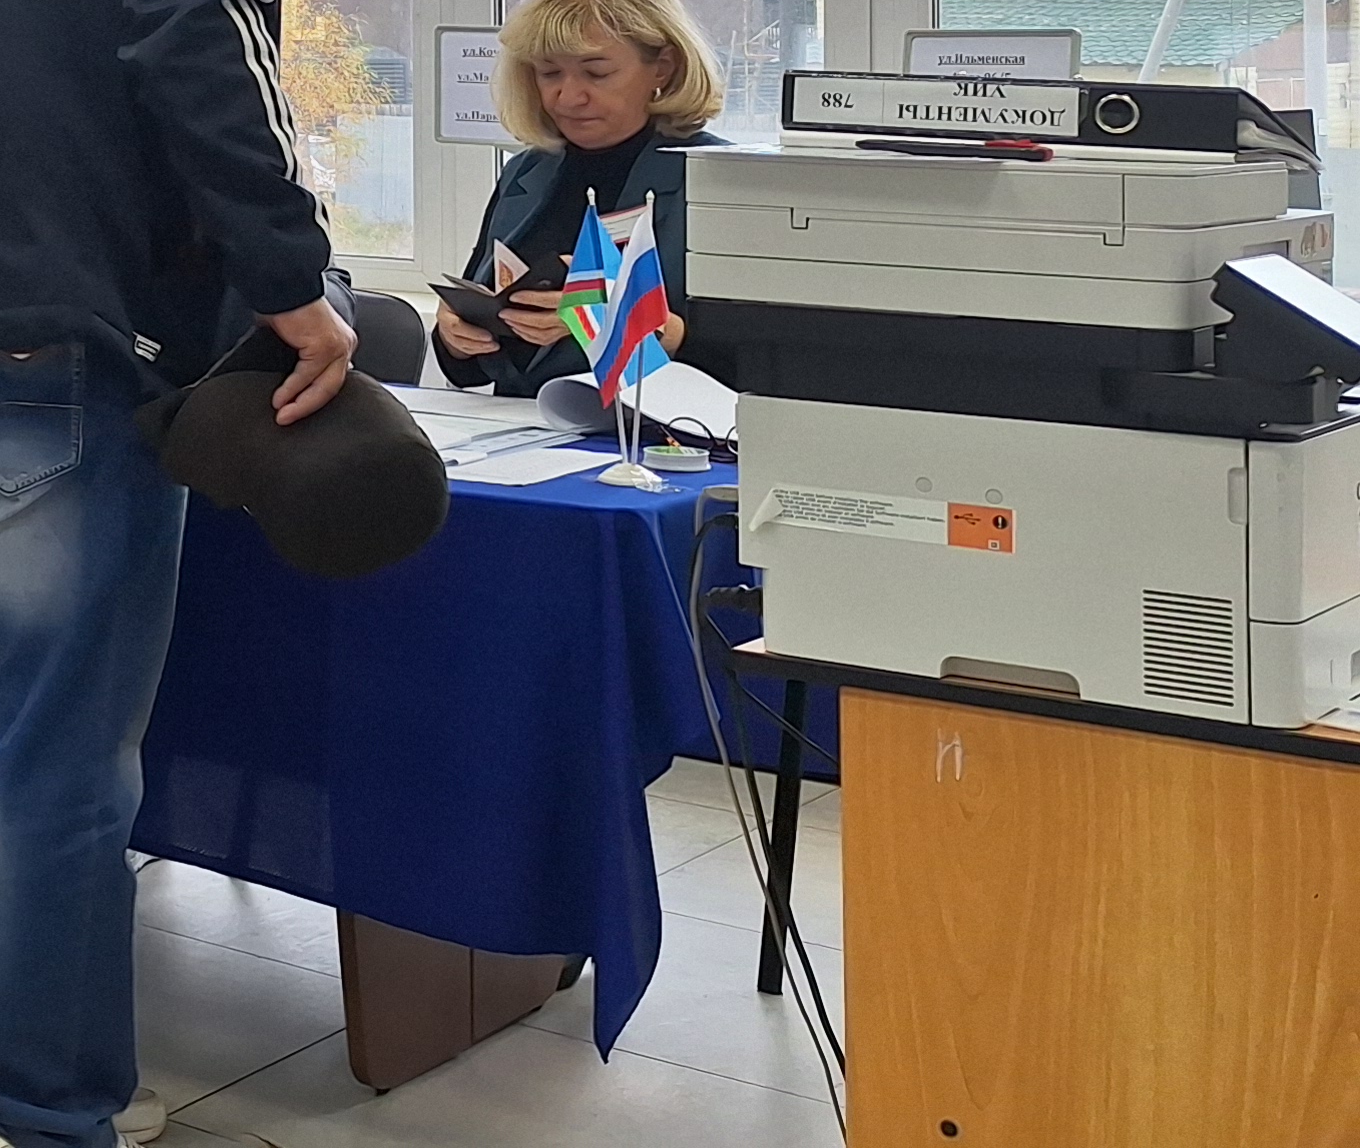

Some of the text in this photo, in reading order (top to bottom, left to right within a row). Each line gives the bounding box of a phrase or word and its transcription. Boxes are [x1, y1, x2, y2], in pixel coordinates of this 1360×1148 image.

[938, 53, 1025, 66] ул.Ильменская
[457, 72, 490, 84] ул.Ма
[821, 91, 855, 109] 788
[455, 111, 499, 123] ул.Парк
[897, 103, 1066, 127] ДОКУМЕНТЫ
